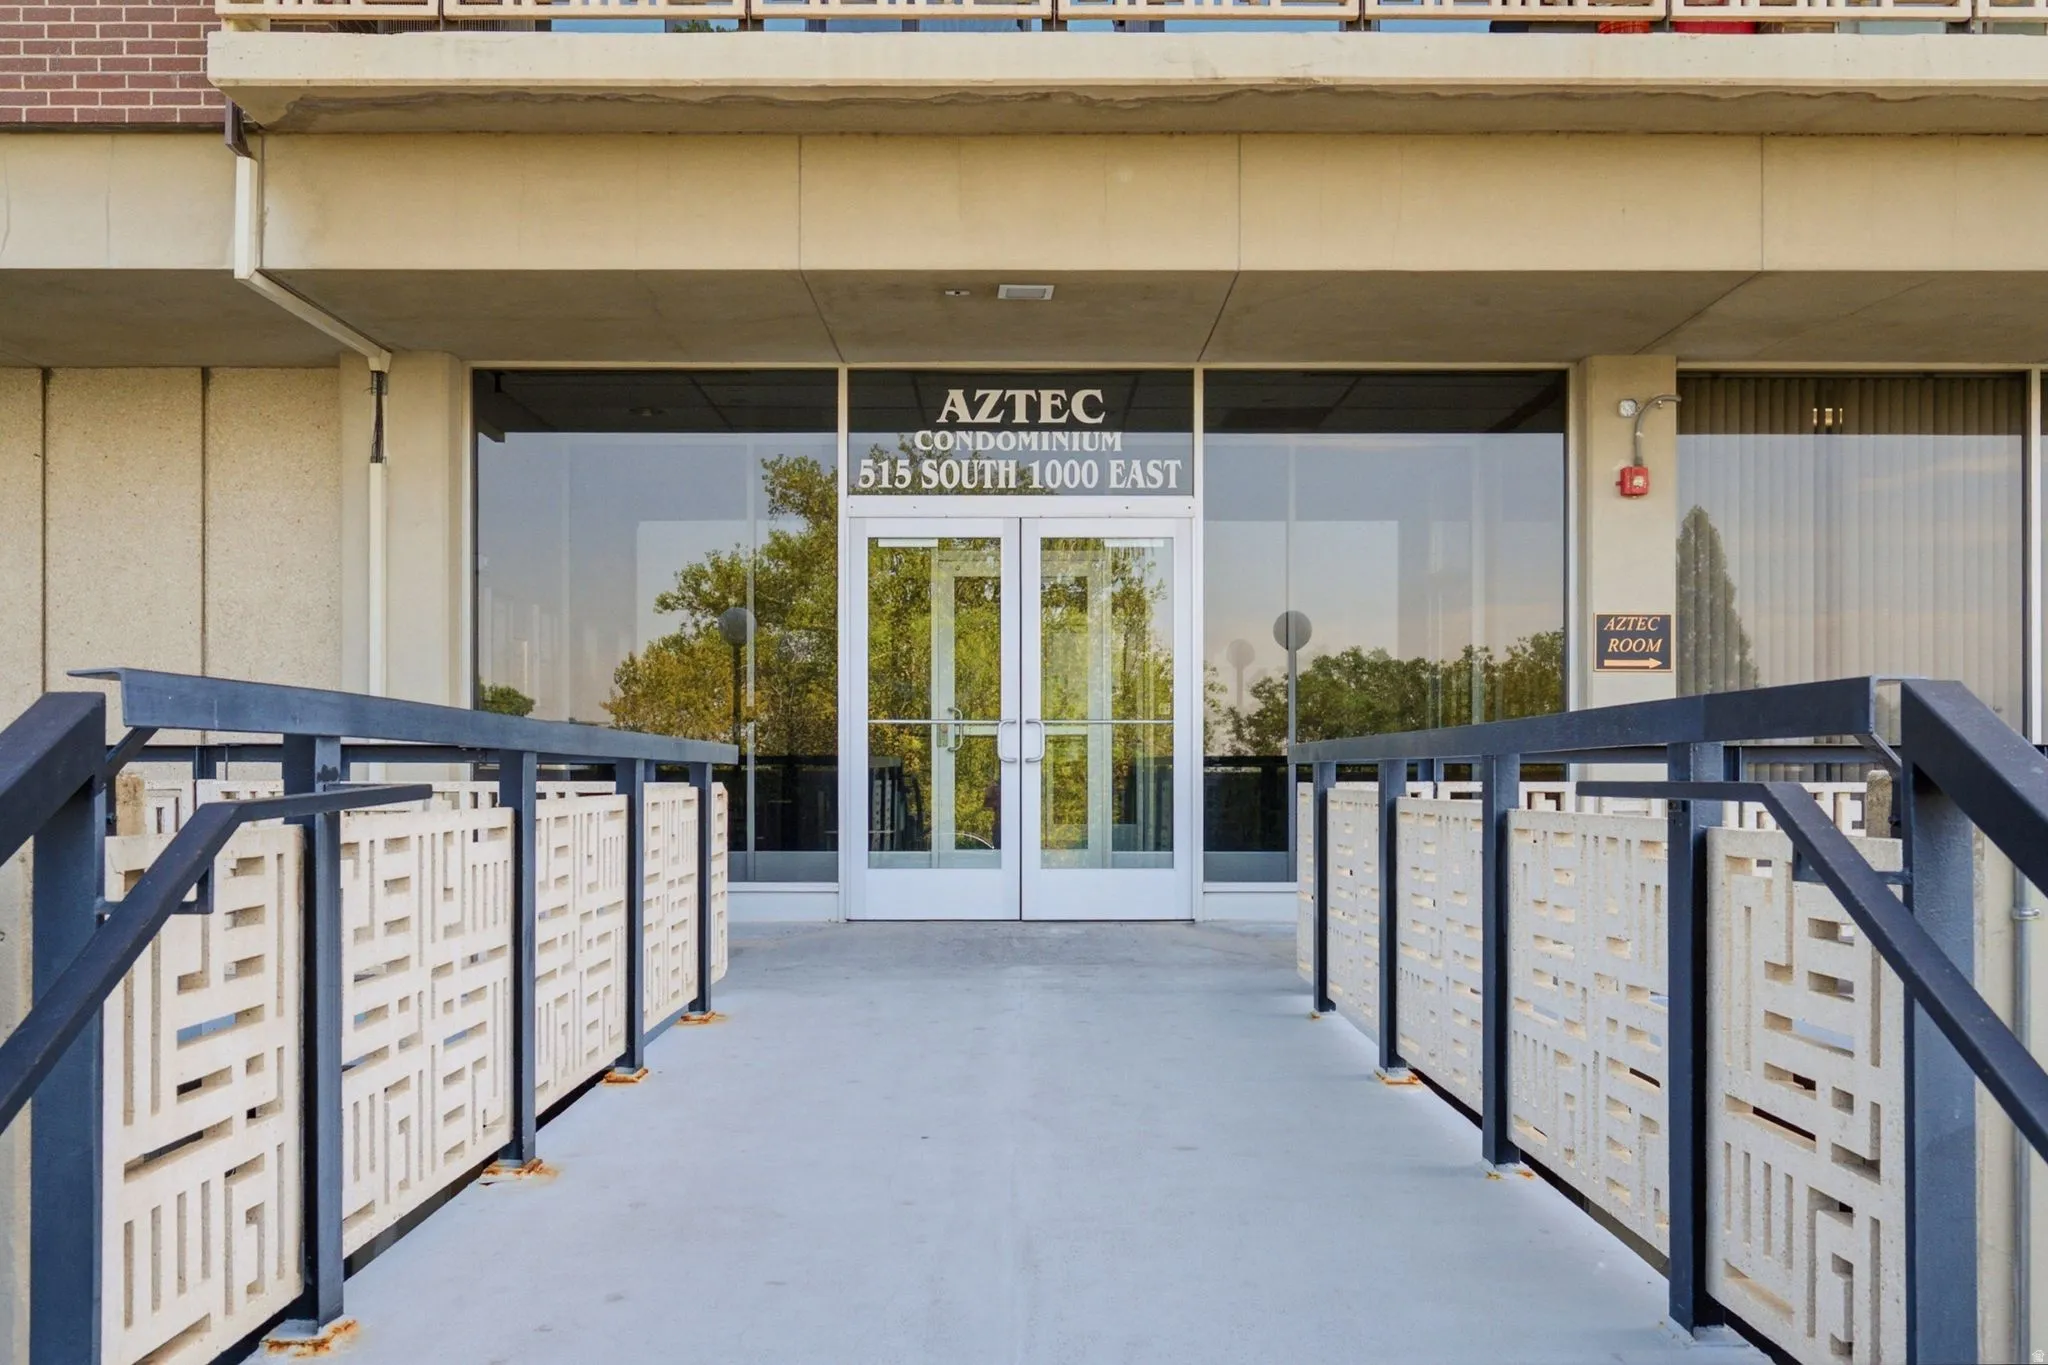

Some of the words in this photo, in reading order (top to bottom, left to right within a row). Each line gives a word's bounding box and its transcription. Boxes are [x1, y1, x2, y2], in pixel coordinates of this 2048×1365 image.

[936, 389, 1106, 424] AZTEC
[914, 430, 1122, 452] CONDOMINIUM
[858, 459, 912, 489] 515
[921, 459, 1018, 489] SOUTH
[1029, 459, 1099, 489] 1000
[1108, 459, 1182, 489] EAST
[1603, 616, 1661, 631] AZTEC
[1607, 637, 1663, 653] ROOM
